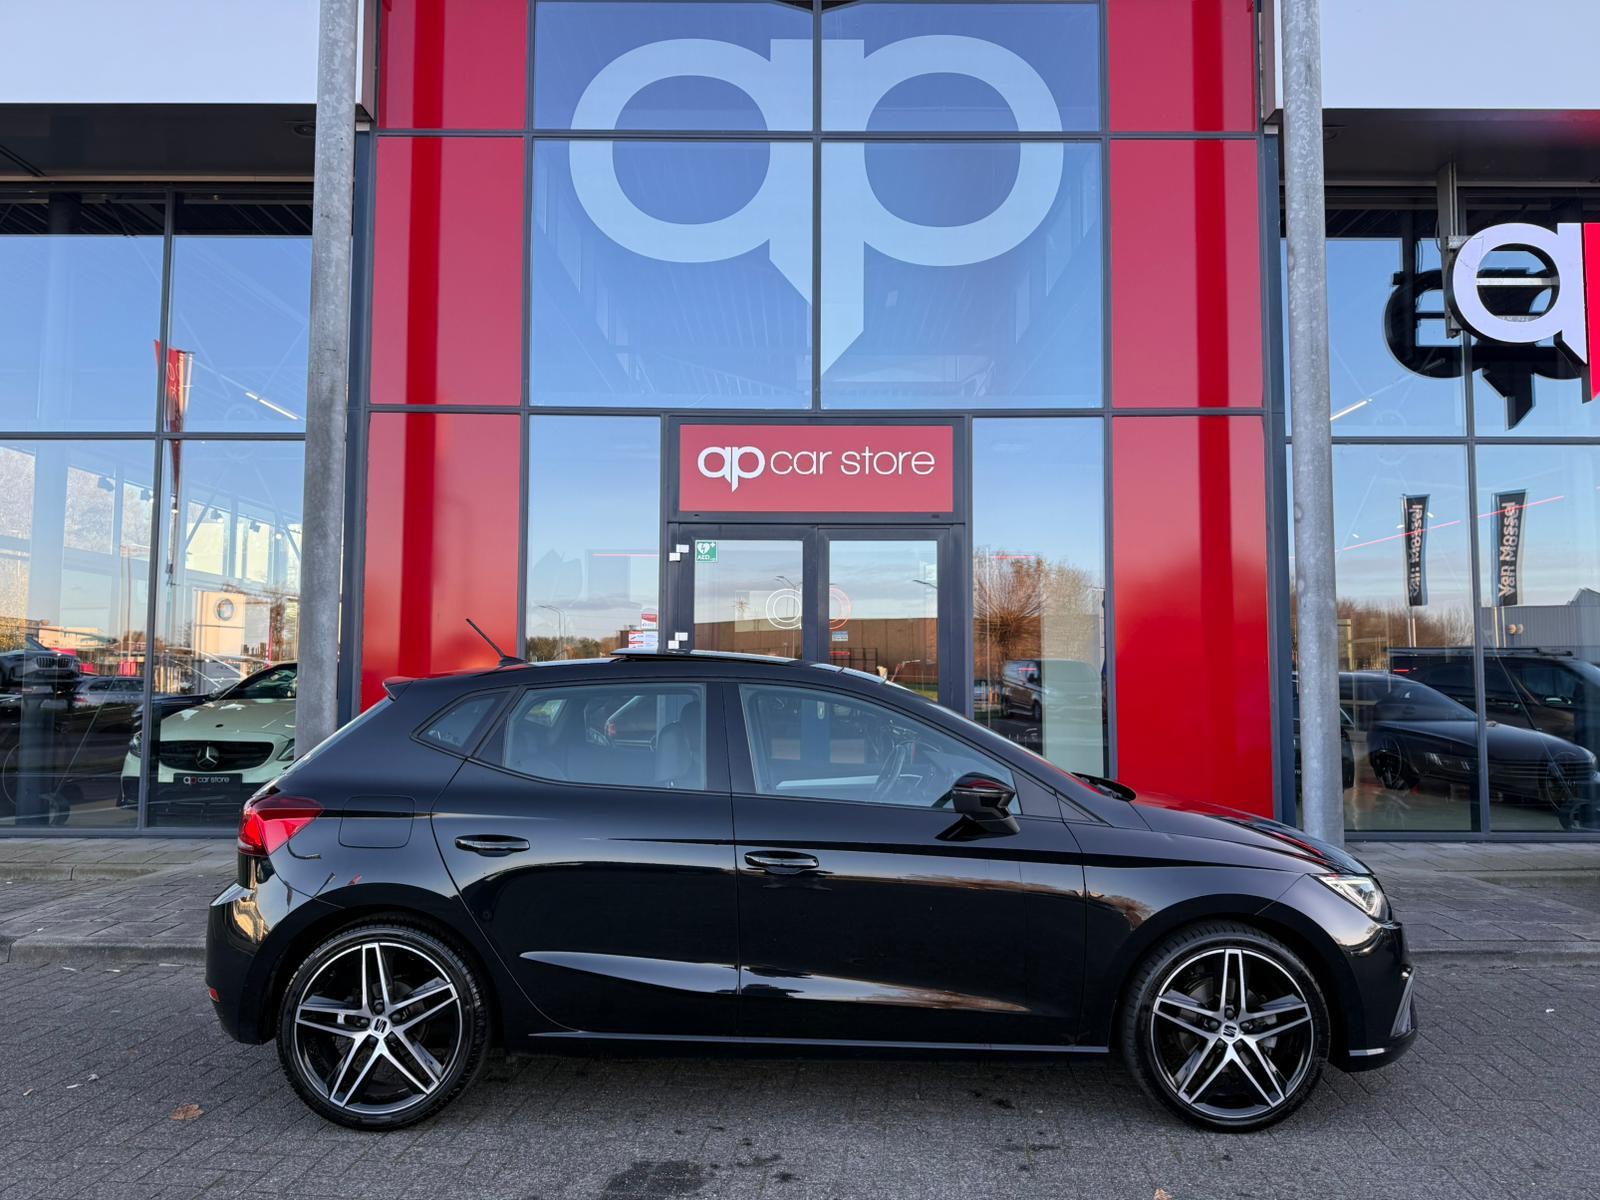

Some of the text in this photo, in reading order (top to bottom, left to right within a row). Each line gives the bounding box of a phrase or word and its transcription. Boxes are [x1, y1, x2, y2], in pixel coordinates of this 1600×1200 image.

[569, 35, 1064, 377] ap
[1453, 222, 1600, 400] a
[698, 446, 935, 492] ap car store
[210, 776, 230, 784] store
